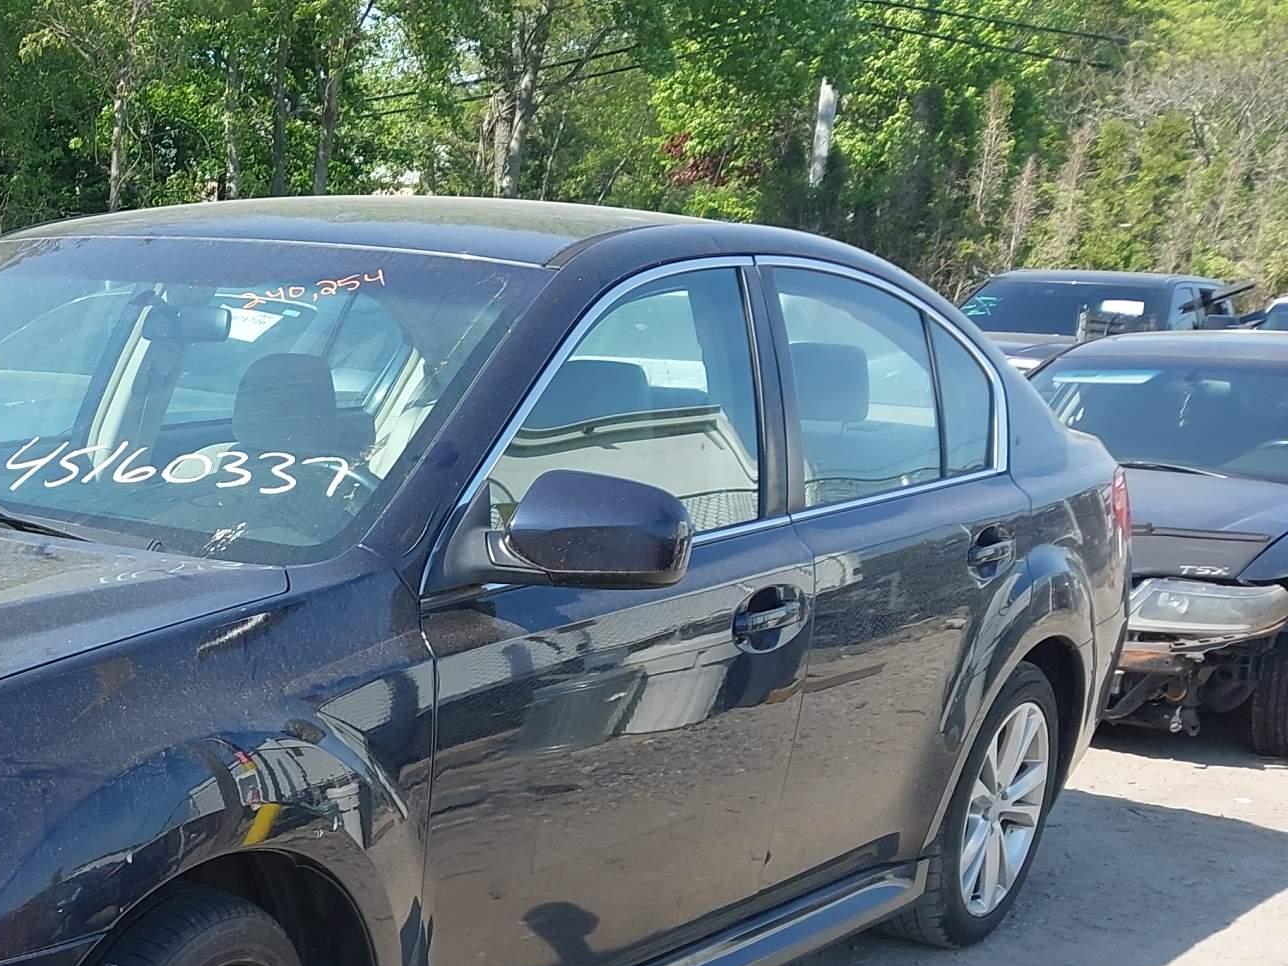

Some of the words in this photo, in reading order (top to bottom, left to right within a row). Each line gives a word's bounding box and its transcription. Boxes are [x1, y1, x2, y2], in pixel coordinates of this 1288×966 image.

[240, 269, 385, 309] 240,254
[5, 436, 349, 497] 45160337
[1179, 565, 1230, 575] TSX
